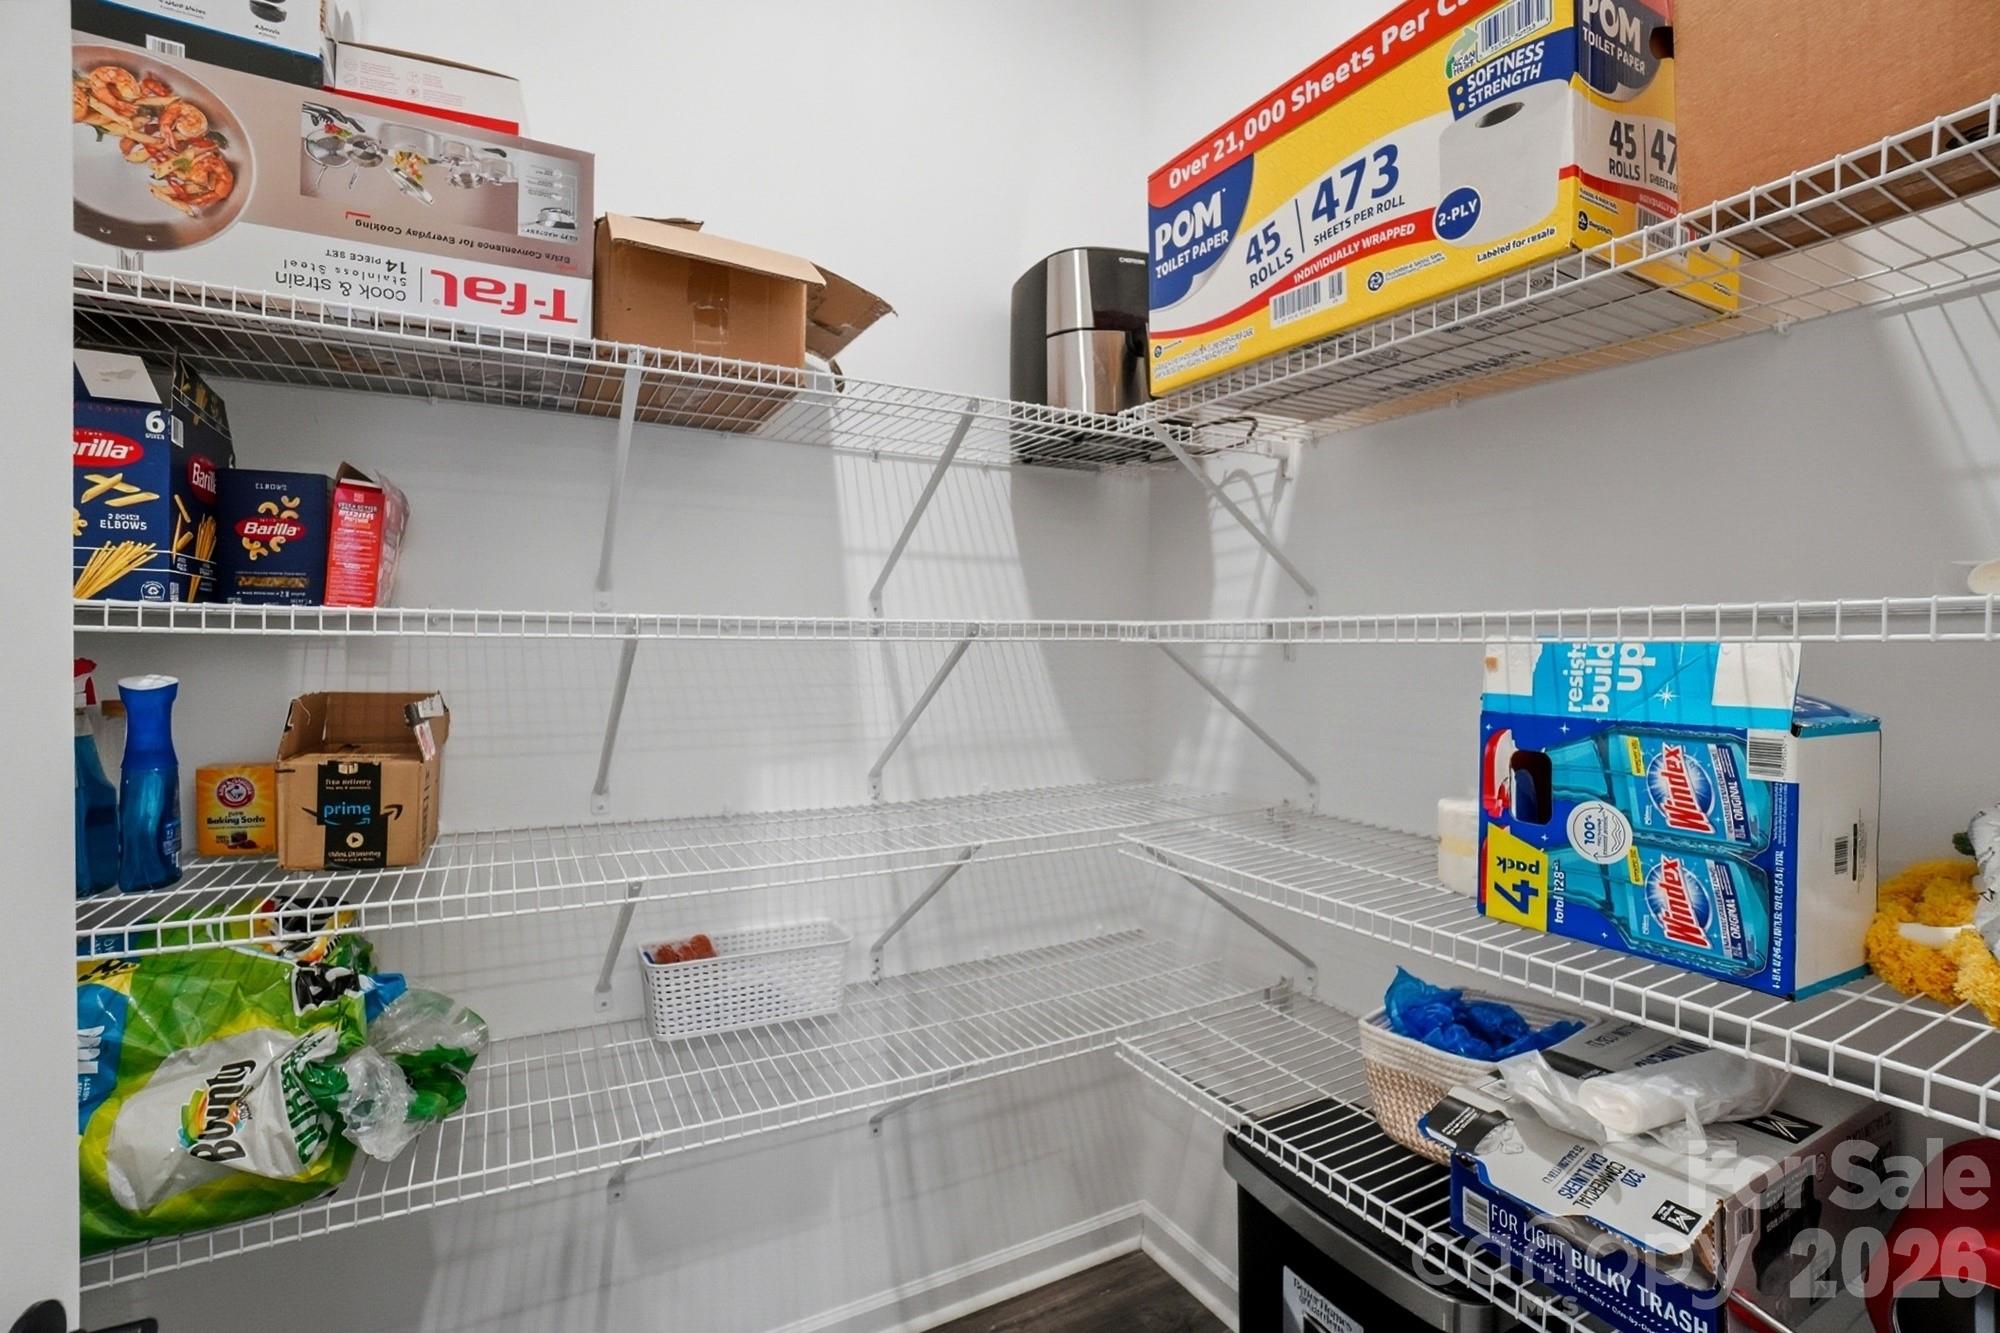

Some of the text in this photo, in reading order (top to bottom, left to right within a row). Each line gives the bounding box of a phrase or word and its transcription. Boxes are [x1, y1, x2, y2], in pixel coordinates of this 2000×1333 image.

[1582, 0, 1641, 54] POM
[1466, 41, 1545, 93] SOFTNESS
[1582, 26, 1646, 76] TOILET PAPER
[1168, 152, 1209, 189] Over
[1213, 99, 1286, 161] 21,000
[1290, 47, 1375, 113] Sheets
[1381, 9, 1430, 55] Per
[1467, 62, 1542, 108] STRENGTH
[1608, 119, 1637, 160] 45
[1311, 143, 1400, 223] 473
[1608, 157, 1641, 181] ROLLS
[355, 218, 402, 235] Cooking
[1155, 190, 1222, 261] POM
[1313, 194, 1406, 247] SHEETS PER ROLL
[1437, 198, 1479, 227] 2-PLY
[405, 228, 455, 245] Everyday
[457, 238, 475, 248] for
[1155, 229, 1230, 279] TOILET PAPER
[1245, 220, 1281, 266] 45
[1292, 242, 1361, 284] INDIVIDUALLY
[1361, 222, 1416, 249] WRAPPED
[1476, 242, 1511, 263] Labeled
[1511, 239, 1526, 252] for
[282, 259, 327, 275] Steel
[325, 249, 407, 274] 14 PIECE SET
[1249, 247, 1294, 289] ROLLS
[275, 271, 407, 302] cook & strain
[431, 269, 578, 323] T-fal
[145, 410, 166, 433] 6
[99, 519, 148, 531] ELBOWS
[243, 521, 298, 536] Barilla
[1582, 643, 1615, 712] build
[1616, 643, 1656, 691] up
[324, 801, 371, 818] prime
[1660, 746, 1711, 832] Windex
[207, 815, 265, 825] Baking Soda
[1496, 856, 1540, 875] pack
[1494, 879, 1539, 915] 4
[1553, 895, 1564, 924] total
[1658, 858, 1708, 947] Windex
[189, 1058, 256, 1163] Bounty
[1557, 1152, 1609, 1200] CAN LINERS
[1572, 1161, 1626, 1209] COMMERCIAL
[1620, 1168, 1647, 1188] 320
[1491, 1203, 1708, 1333] FOR LIGHT BULKY TRASH
